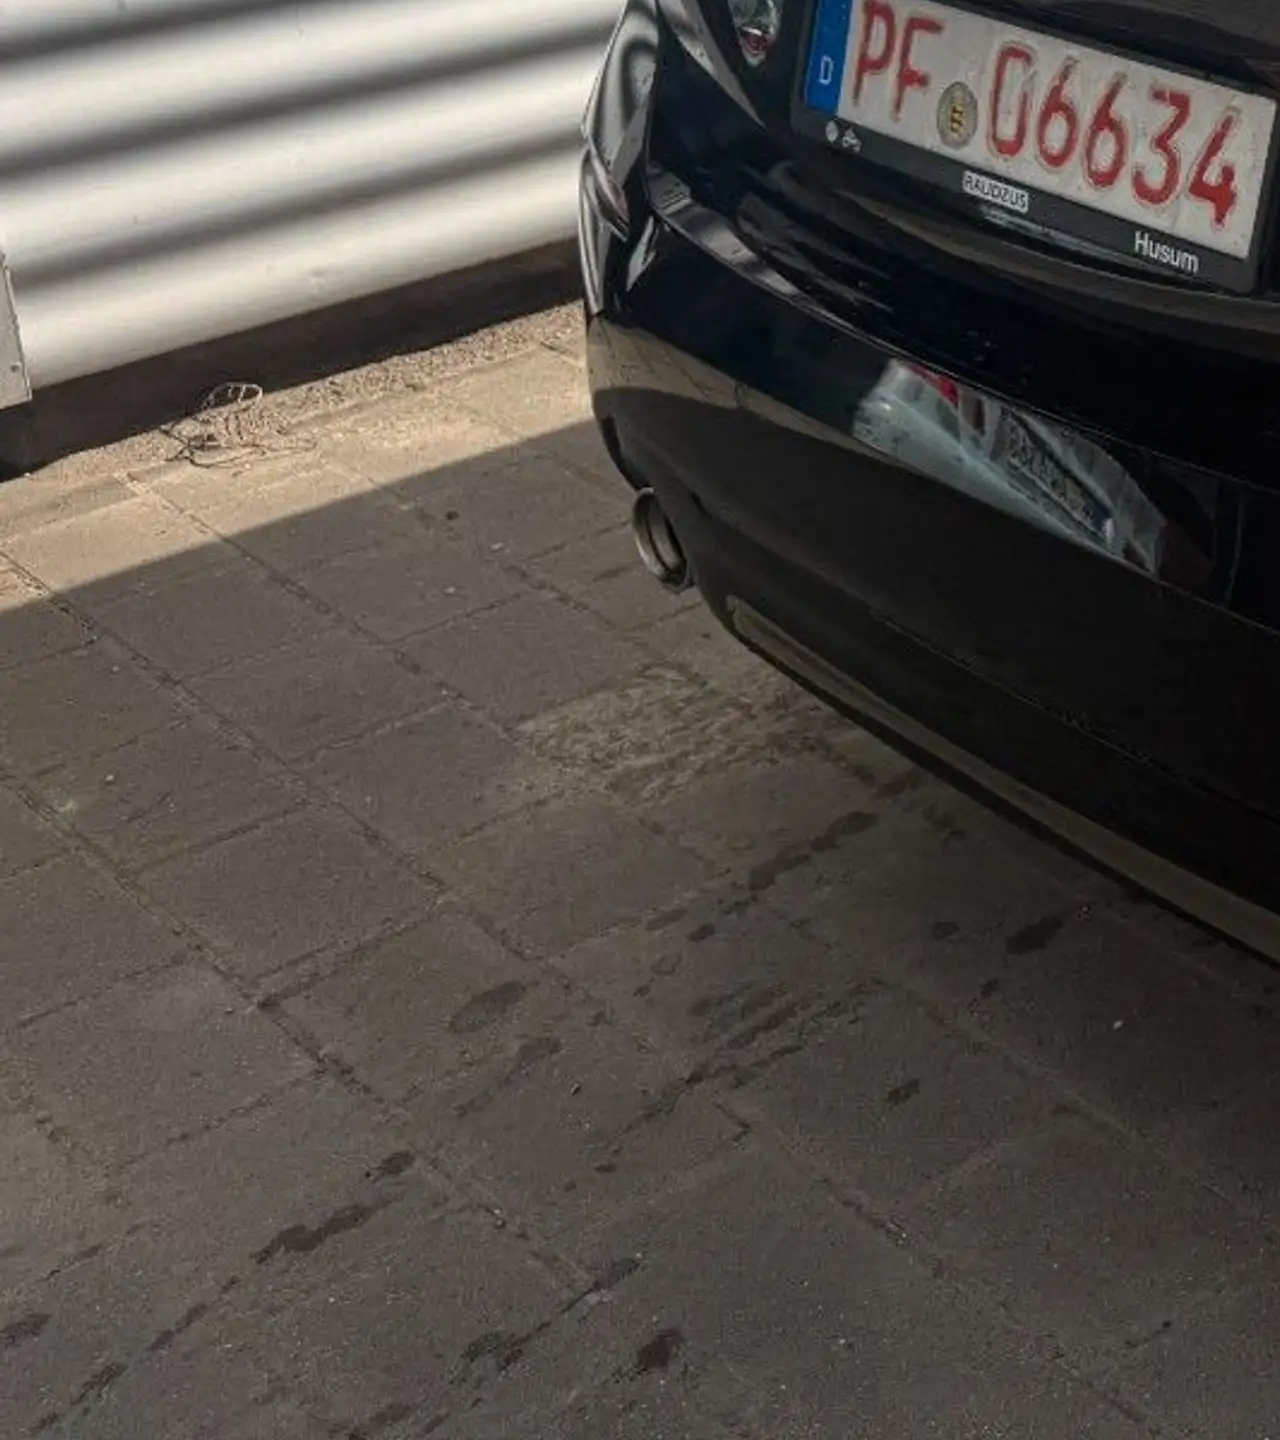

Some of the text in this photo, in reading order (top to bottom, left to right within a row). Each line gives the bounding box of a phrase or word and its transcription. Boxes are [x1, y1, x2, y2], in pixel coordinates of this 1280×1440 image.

[818, 55, 834, 85] D
[986, 39, 1241, 230] 06634
[1134, 230, 1199, 274] Husum
